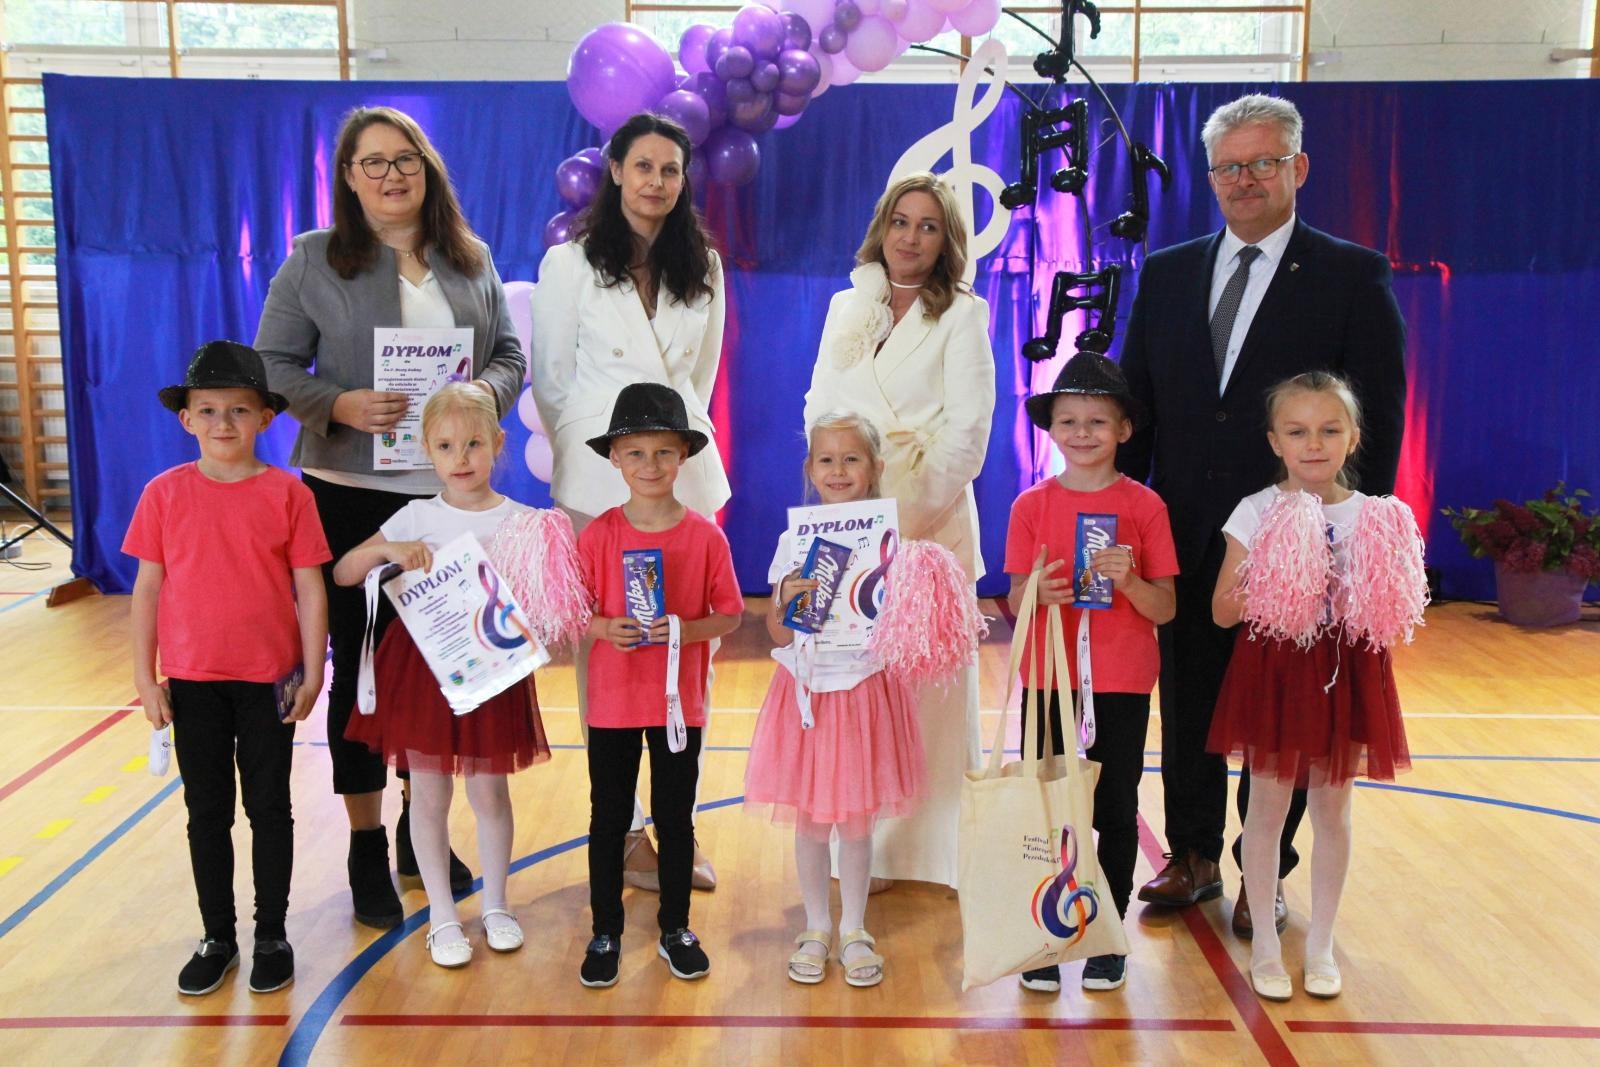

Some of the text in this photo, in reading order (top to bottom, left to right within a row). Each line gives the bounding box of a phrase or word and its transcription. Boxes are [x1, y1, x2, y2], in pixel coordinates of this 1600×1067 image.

[382, 346, 453, 357] DYPLOM
[797, 517, 874, 536] DYPLOM
[398, 560, 463, 607] DYPLOM
[626, 578, 654, 632] Milka
[814, 554, 839, 609] Milka
